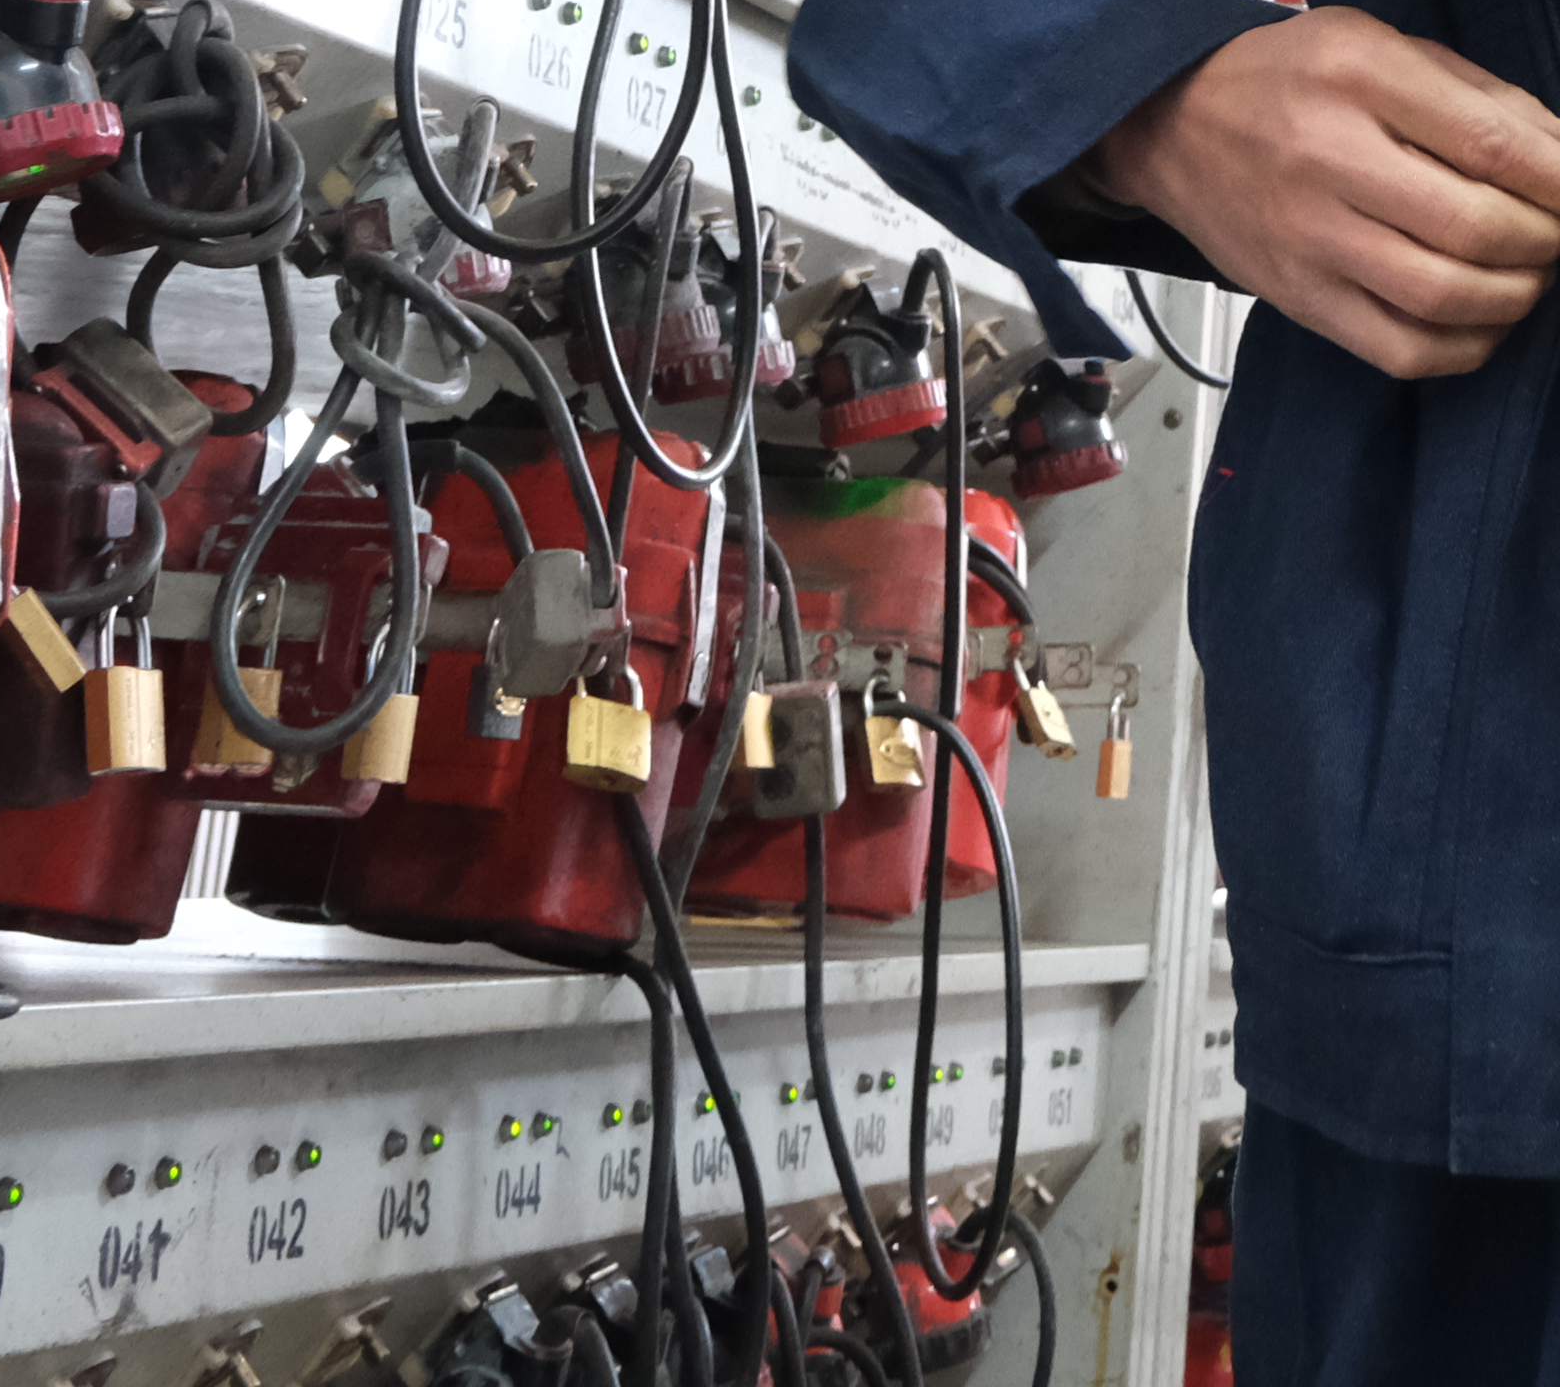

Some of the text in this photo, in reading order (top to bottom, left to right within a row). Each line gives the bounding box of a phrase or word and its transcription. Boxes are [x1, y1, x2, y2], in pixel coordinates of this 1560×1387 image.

[528, 33, 572, 90] 026
[627, 75, 668, 132] 027
[1047, 1088, 1073, 1128] 051
[777, 1124, 813, 1172] 047
[854, 1113, 887, 1160] 048
[494, 1167, 543, 1219] 044
[598, 1150, 641, 1202] 045
[248, 1196, 308, 1265] 042
[378, 1179, 432, 1240] 043
[98, 1219, 171, 1290] 041
